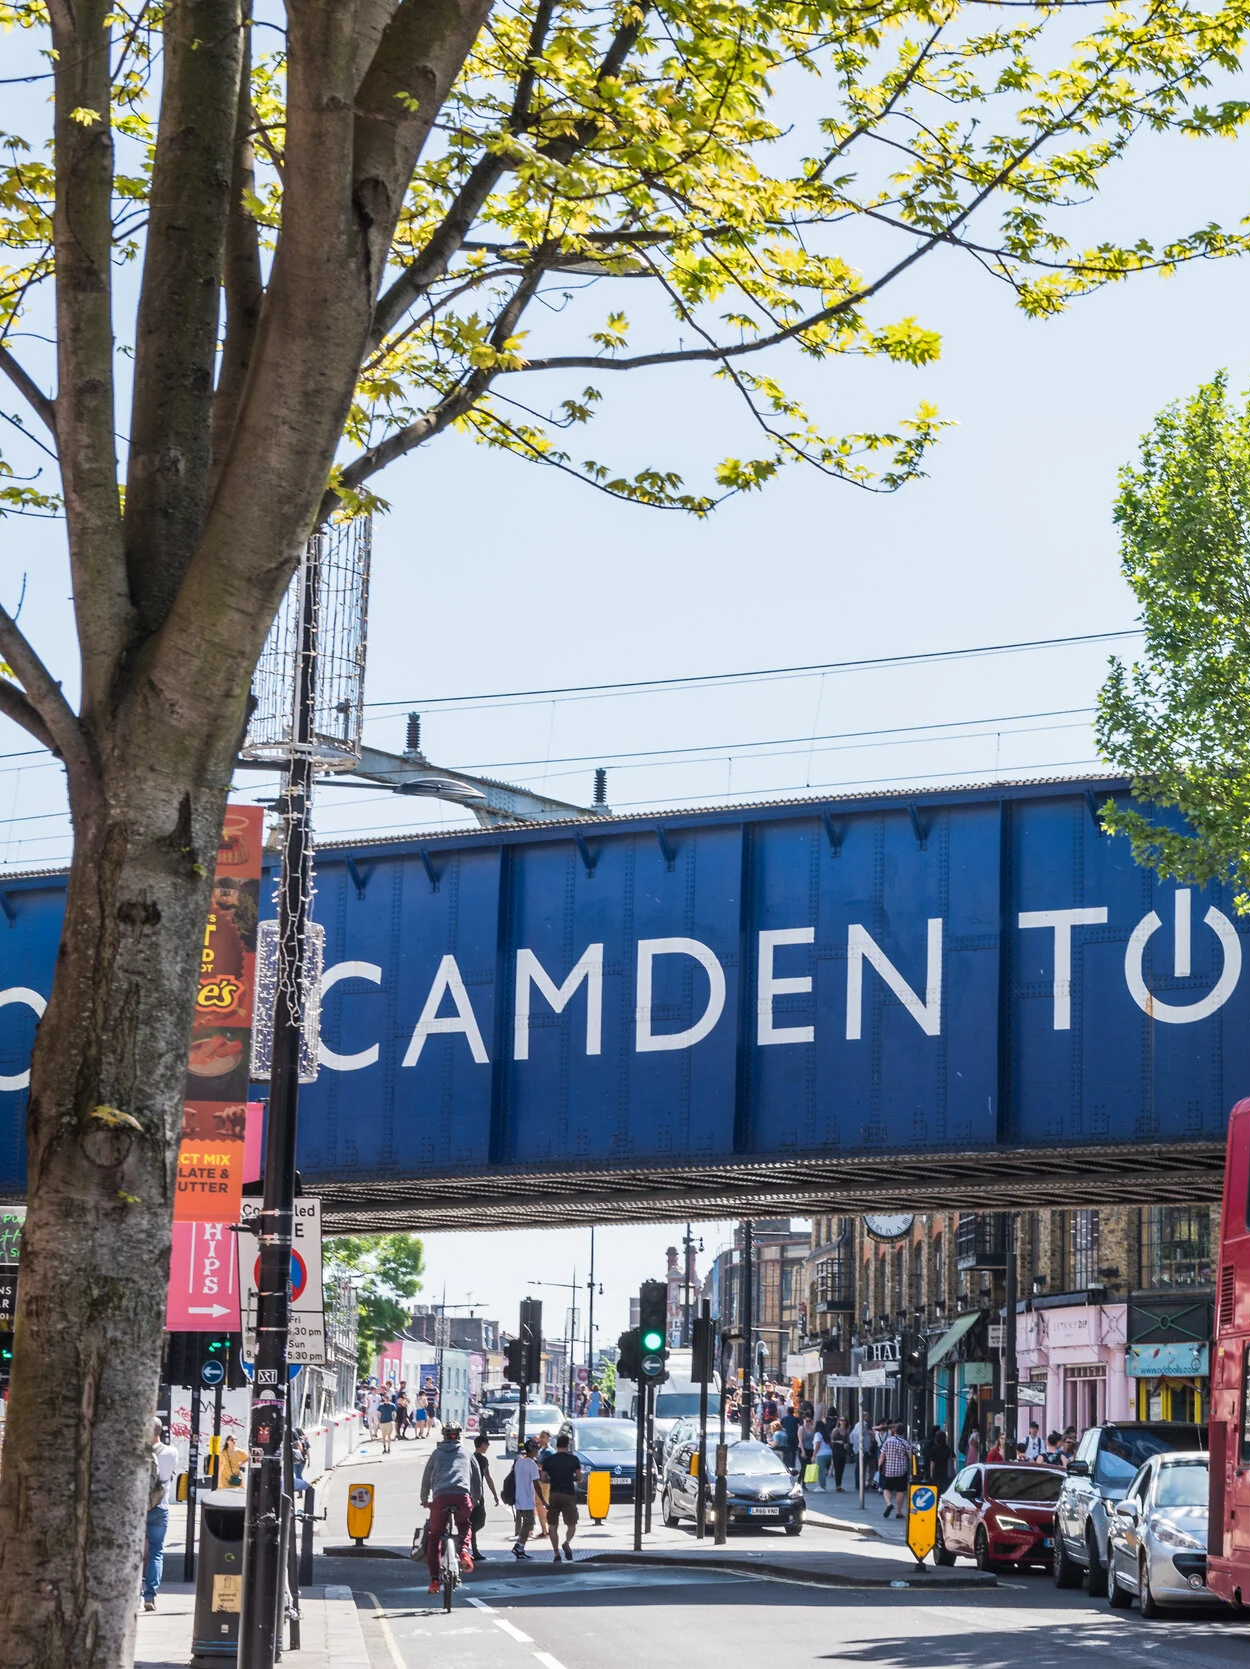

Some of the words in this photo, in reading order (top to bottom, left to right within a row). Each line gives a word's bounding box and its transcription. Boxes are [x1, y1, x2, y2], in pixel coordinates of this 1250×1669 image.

[317, 917, 943, 1071] CAMDEN
[177, 1152, 200, 1165] CT
[203, 1153, 231, 1166] MIX
[179, 1167, 216, 1179] LATE
[220, 1168, 230, 1179] &
[178, 1181, 229, 1193] UTTER
[242, 1203, 315, 1217] Coled
[202, 1223, 223, 1294] HIPS
[308, 1329, 322, 1338] pm
[288, 1339, 306, 1348] Sun
[287, 1351, 308, 1360] 5.30
[309, 1353, 323, 1361] pm
